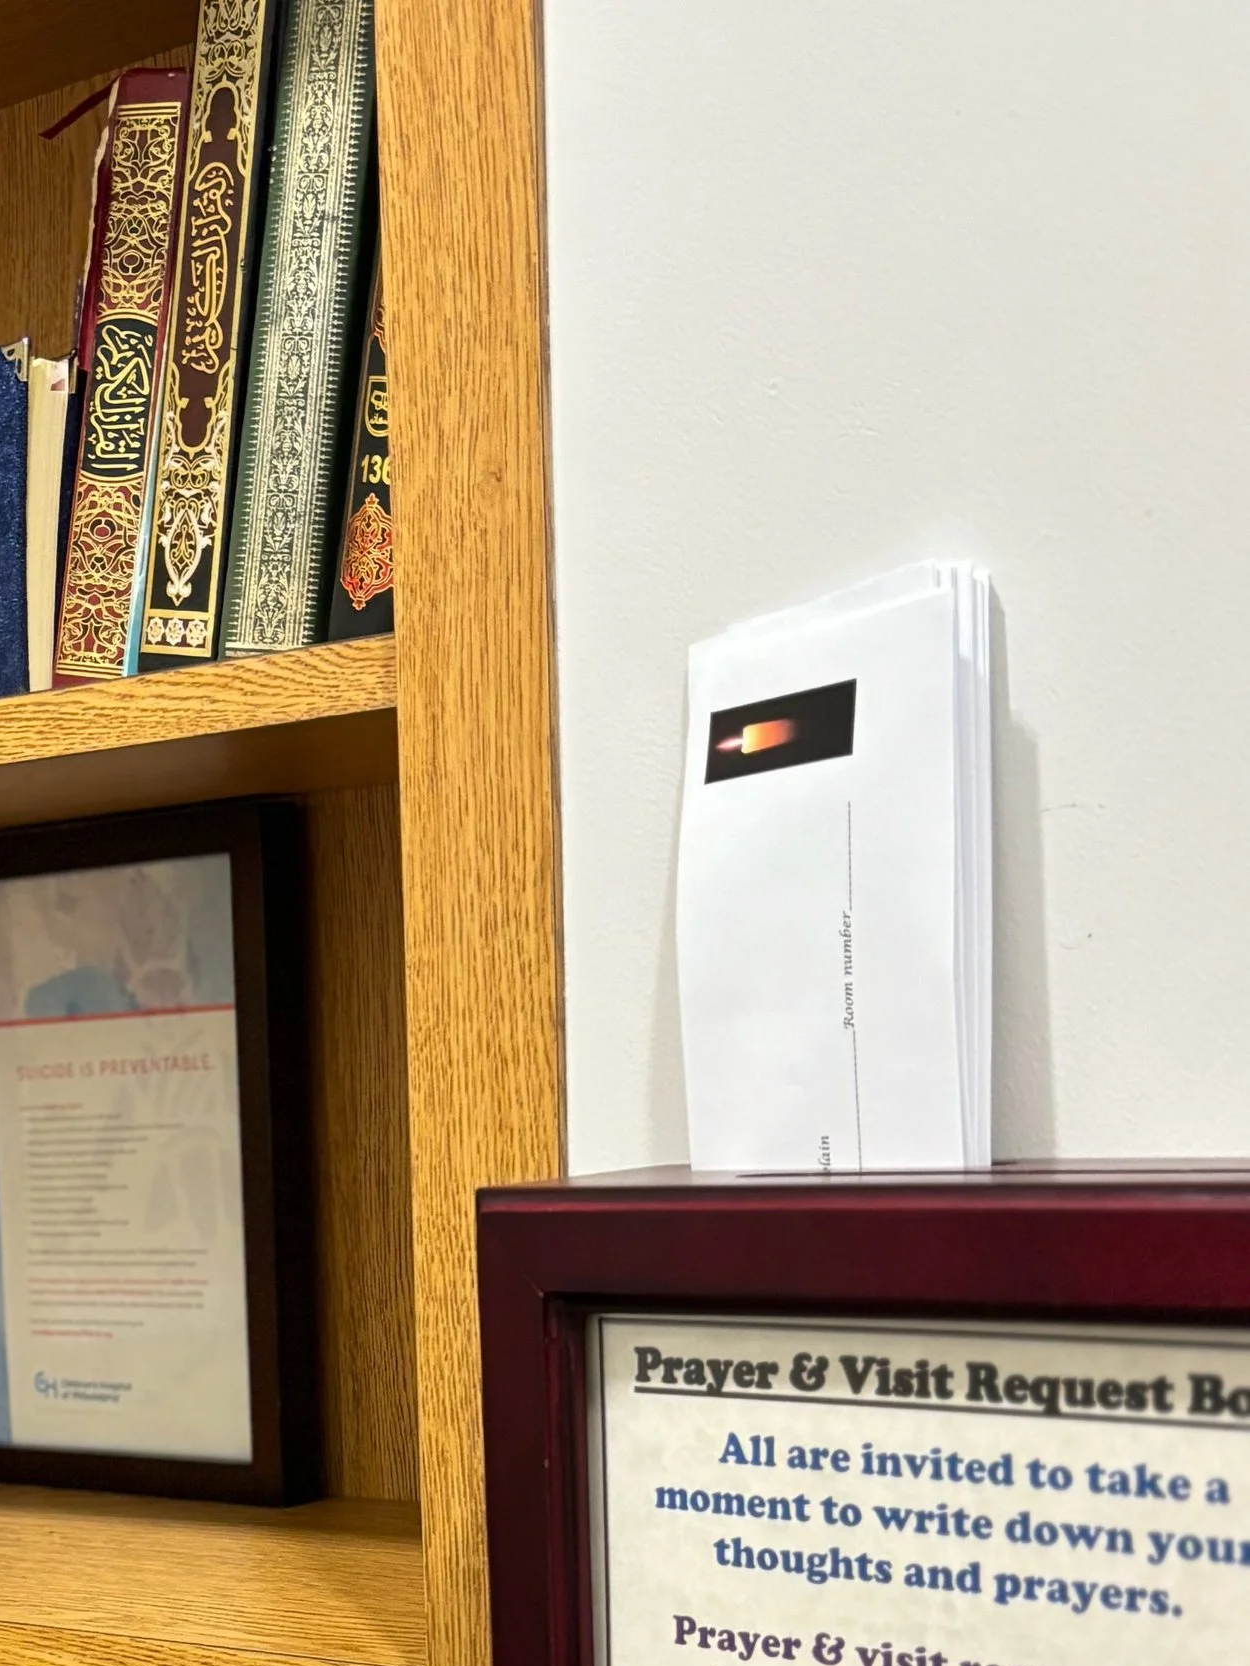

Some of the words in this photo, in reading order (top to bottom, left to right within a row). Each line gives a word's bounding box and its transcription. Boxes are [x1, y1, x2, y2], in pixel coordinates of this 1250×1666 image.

[838, 911, 855, 977] number
[841, 982, 856, 1030] Room
[79, 1062, 95, 1078] IS
[818, 1135, 831, 1172] lain
[633, 1346, 779, 1395] Prayer
[789, 1352, 830, 1392] &
[838, 1354, 955, 1400] Visit
[965, 1361, 1175, 1417] Request
[719, 1433, 776, 1467] All
[788, 1446, 850, 1472] are
[862, 1443, 1014, 1486] invited
[1026, 1459, 1073, 1490] to
[1086, 1464, 1190, 1501] take
[1206, 1479, 1230, 1504] a
[656, 1487, 810, 1522] moment
[821, 1497, 862, 1527] to
[873, 1504, 992, 1539] write
[1005, 1511, 1134, 1554] down
[1148, 1532, 1250, 1566] your
[714, 1537, 892, 1584] thoughts
[904, 1562, 981, 1594] and
[994, 1574, 1182, 1617] prayers.
[673, 1615, 801, 1661] Prayer
[812, 1633, 845, 1665] &
